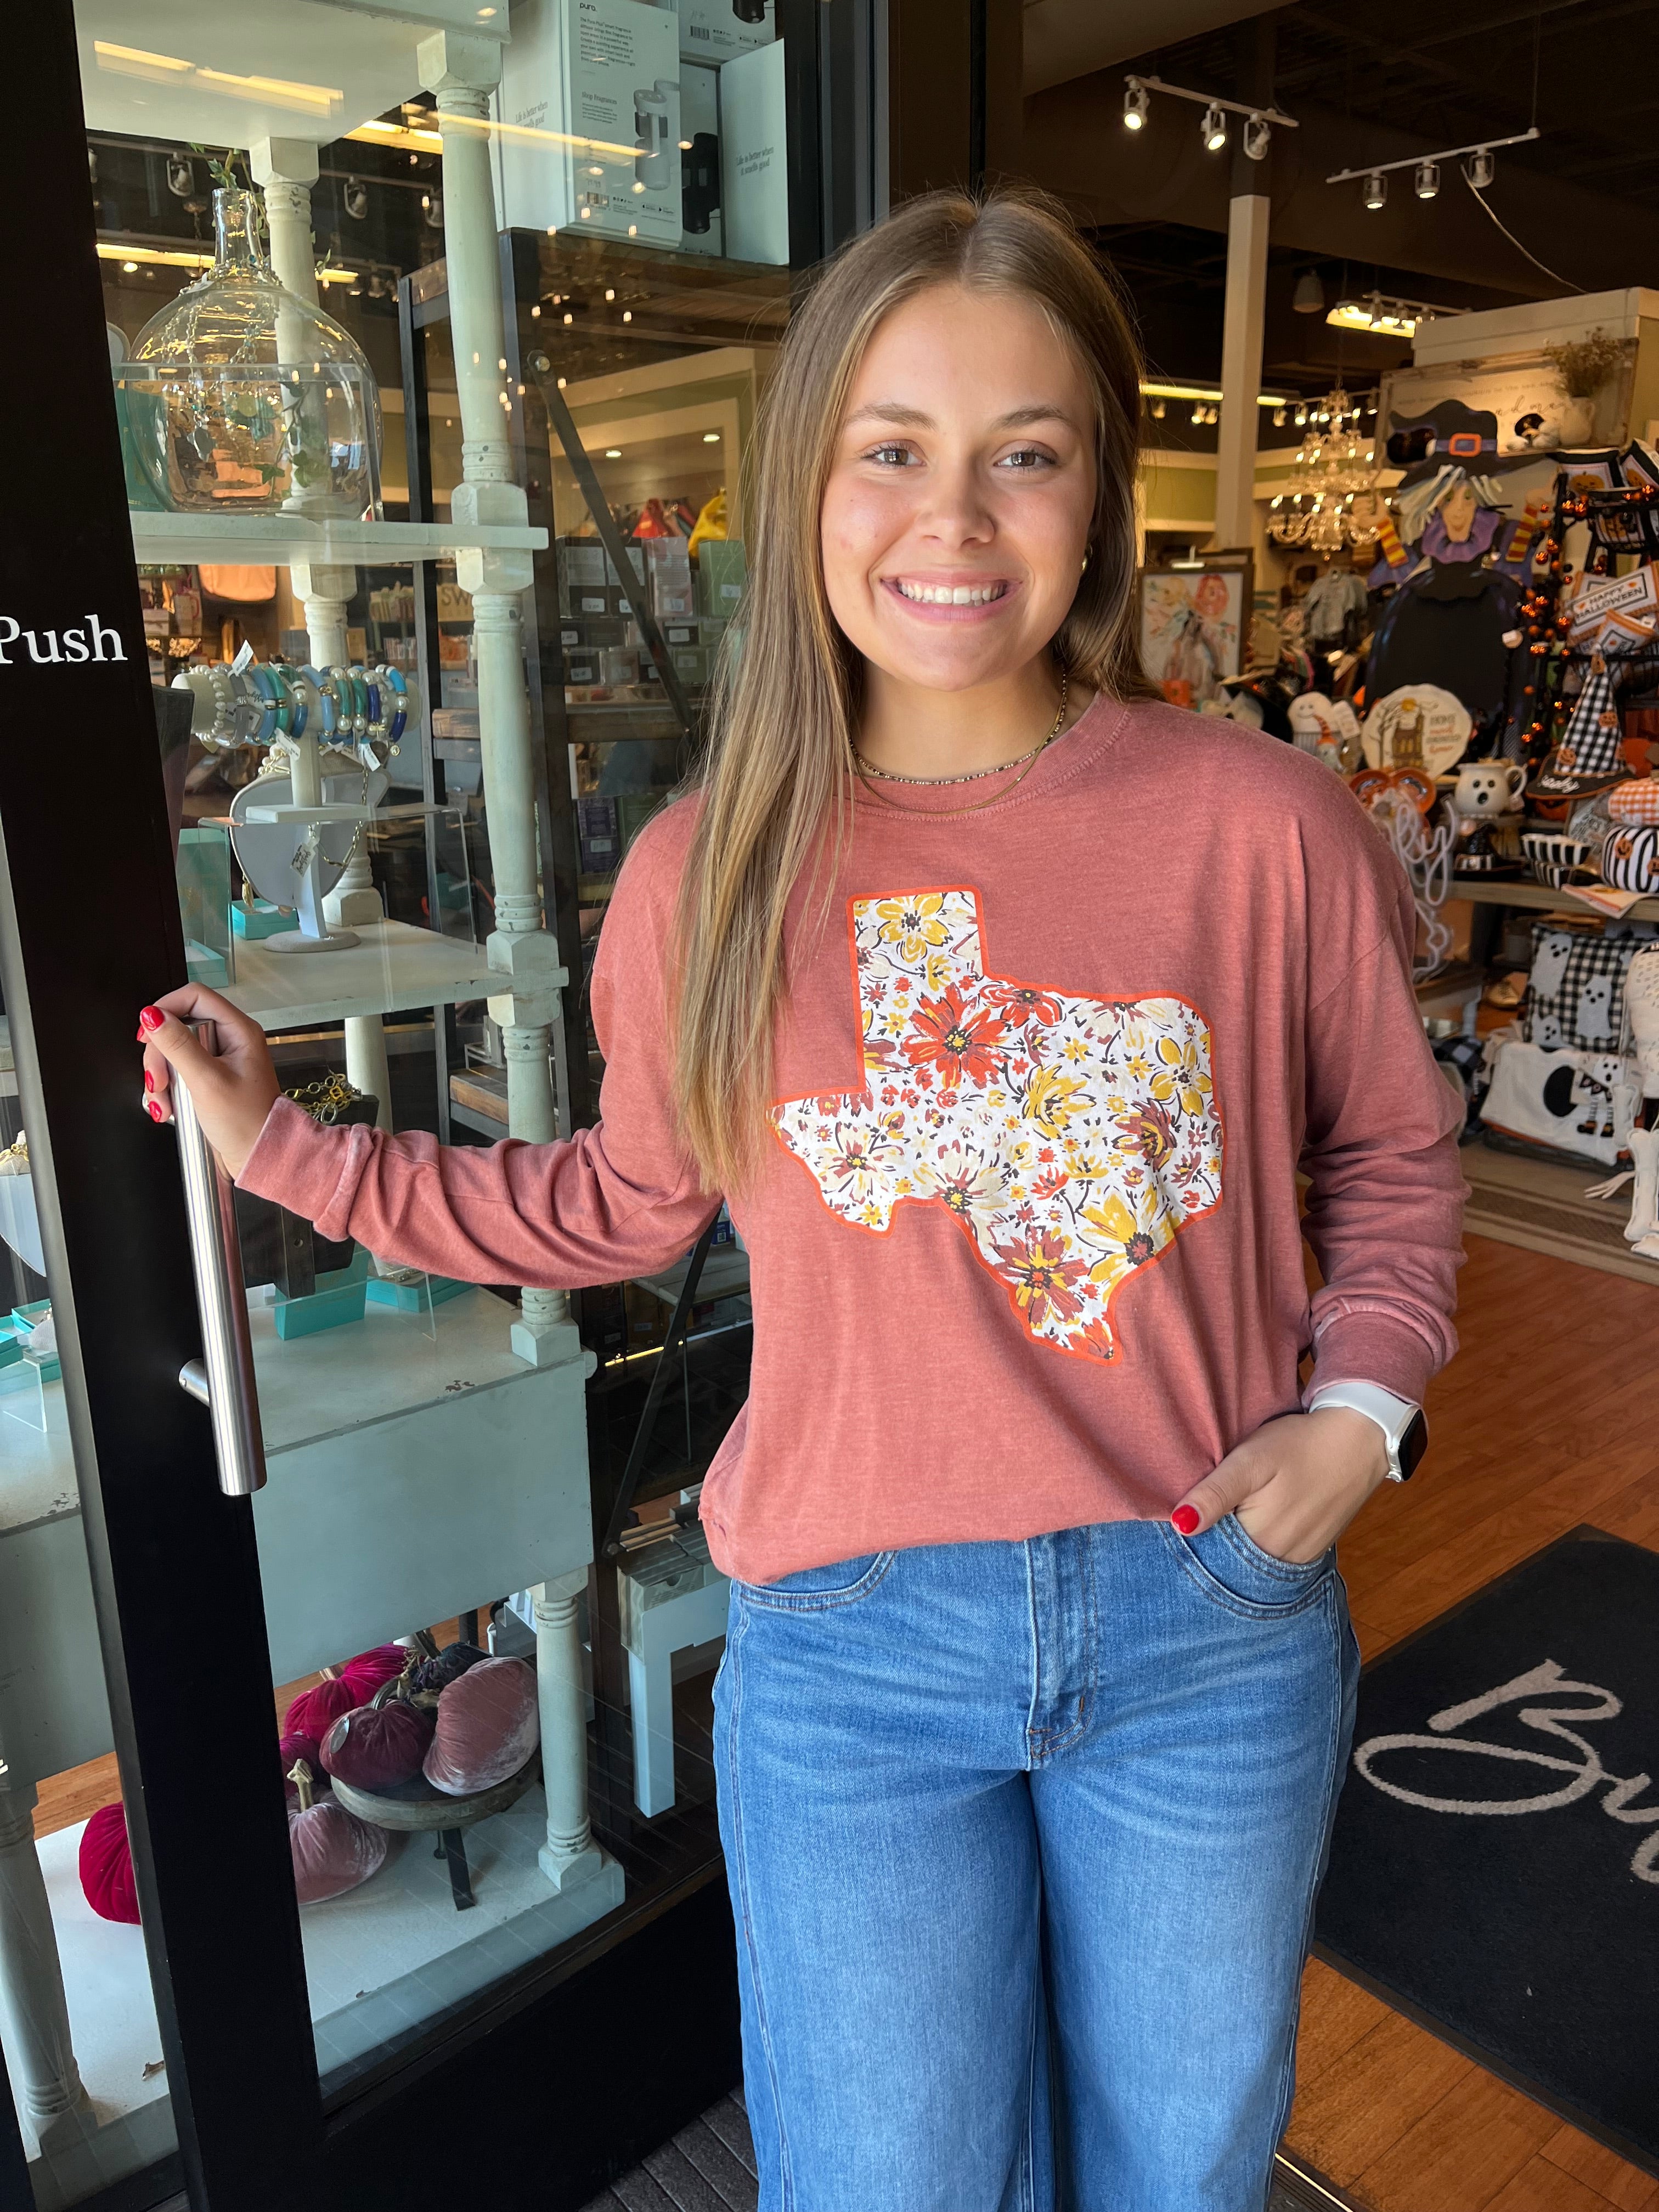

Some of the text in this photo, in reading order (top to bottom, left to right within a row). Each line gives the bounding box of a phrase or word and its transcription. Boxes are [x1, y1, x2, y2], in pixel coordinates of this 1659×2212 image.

[527, 106, 537, 118] better
[749, 151, 761, 161] better
[1576, 586, 1643, 620] HALLOWEEN
[1589, 585, 1624, 603] HAPPY
[0, 614, 128, 664] Push
